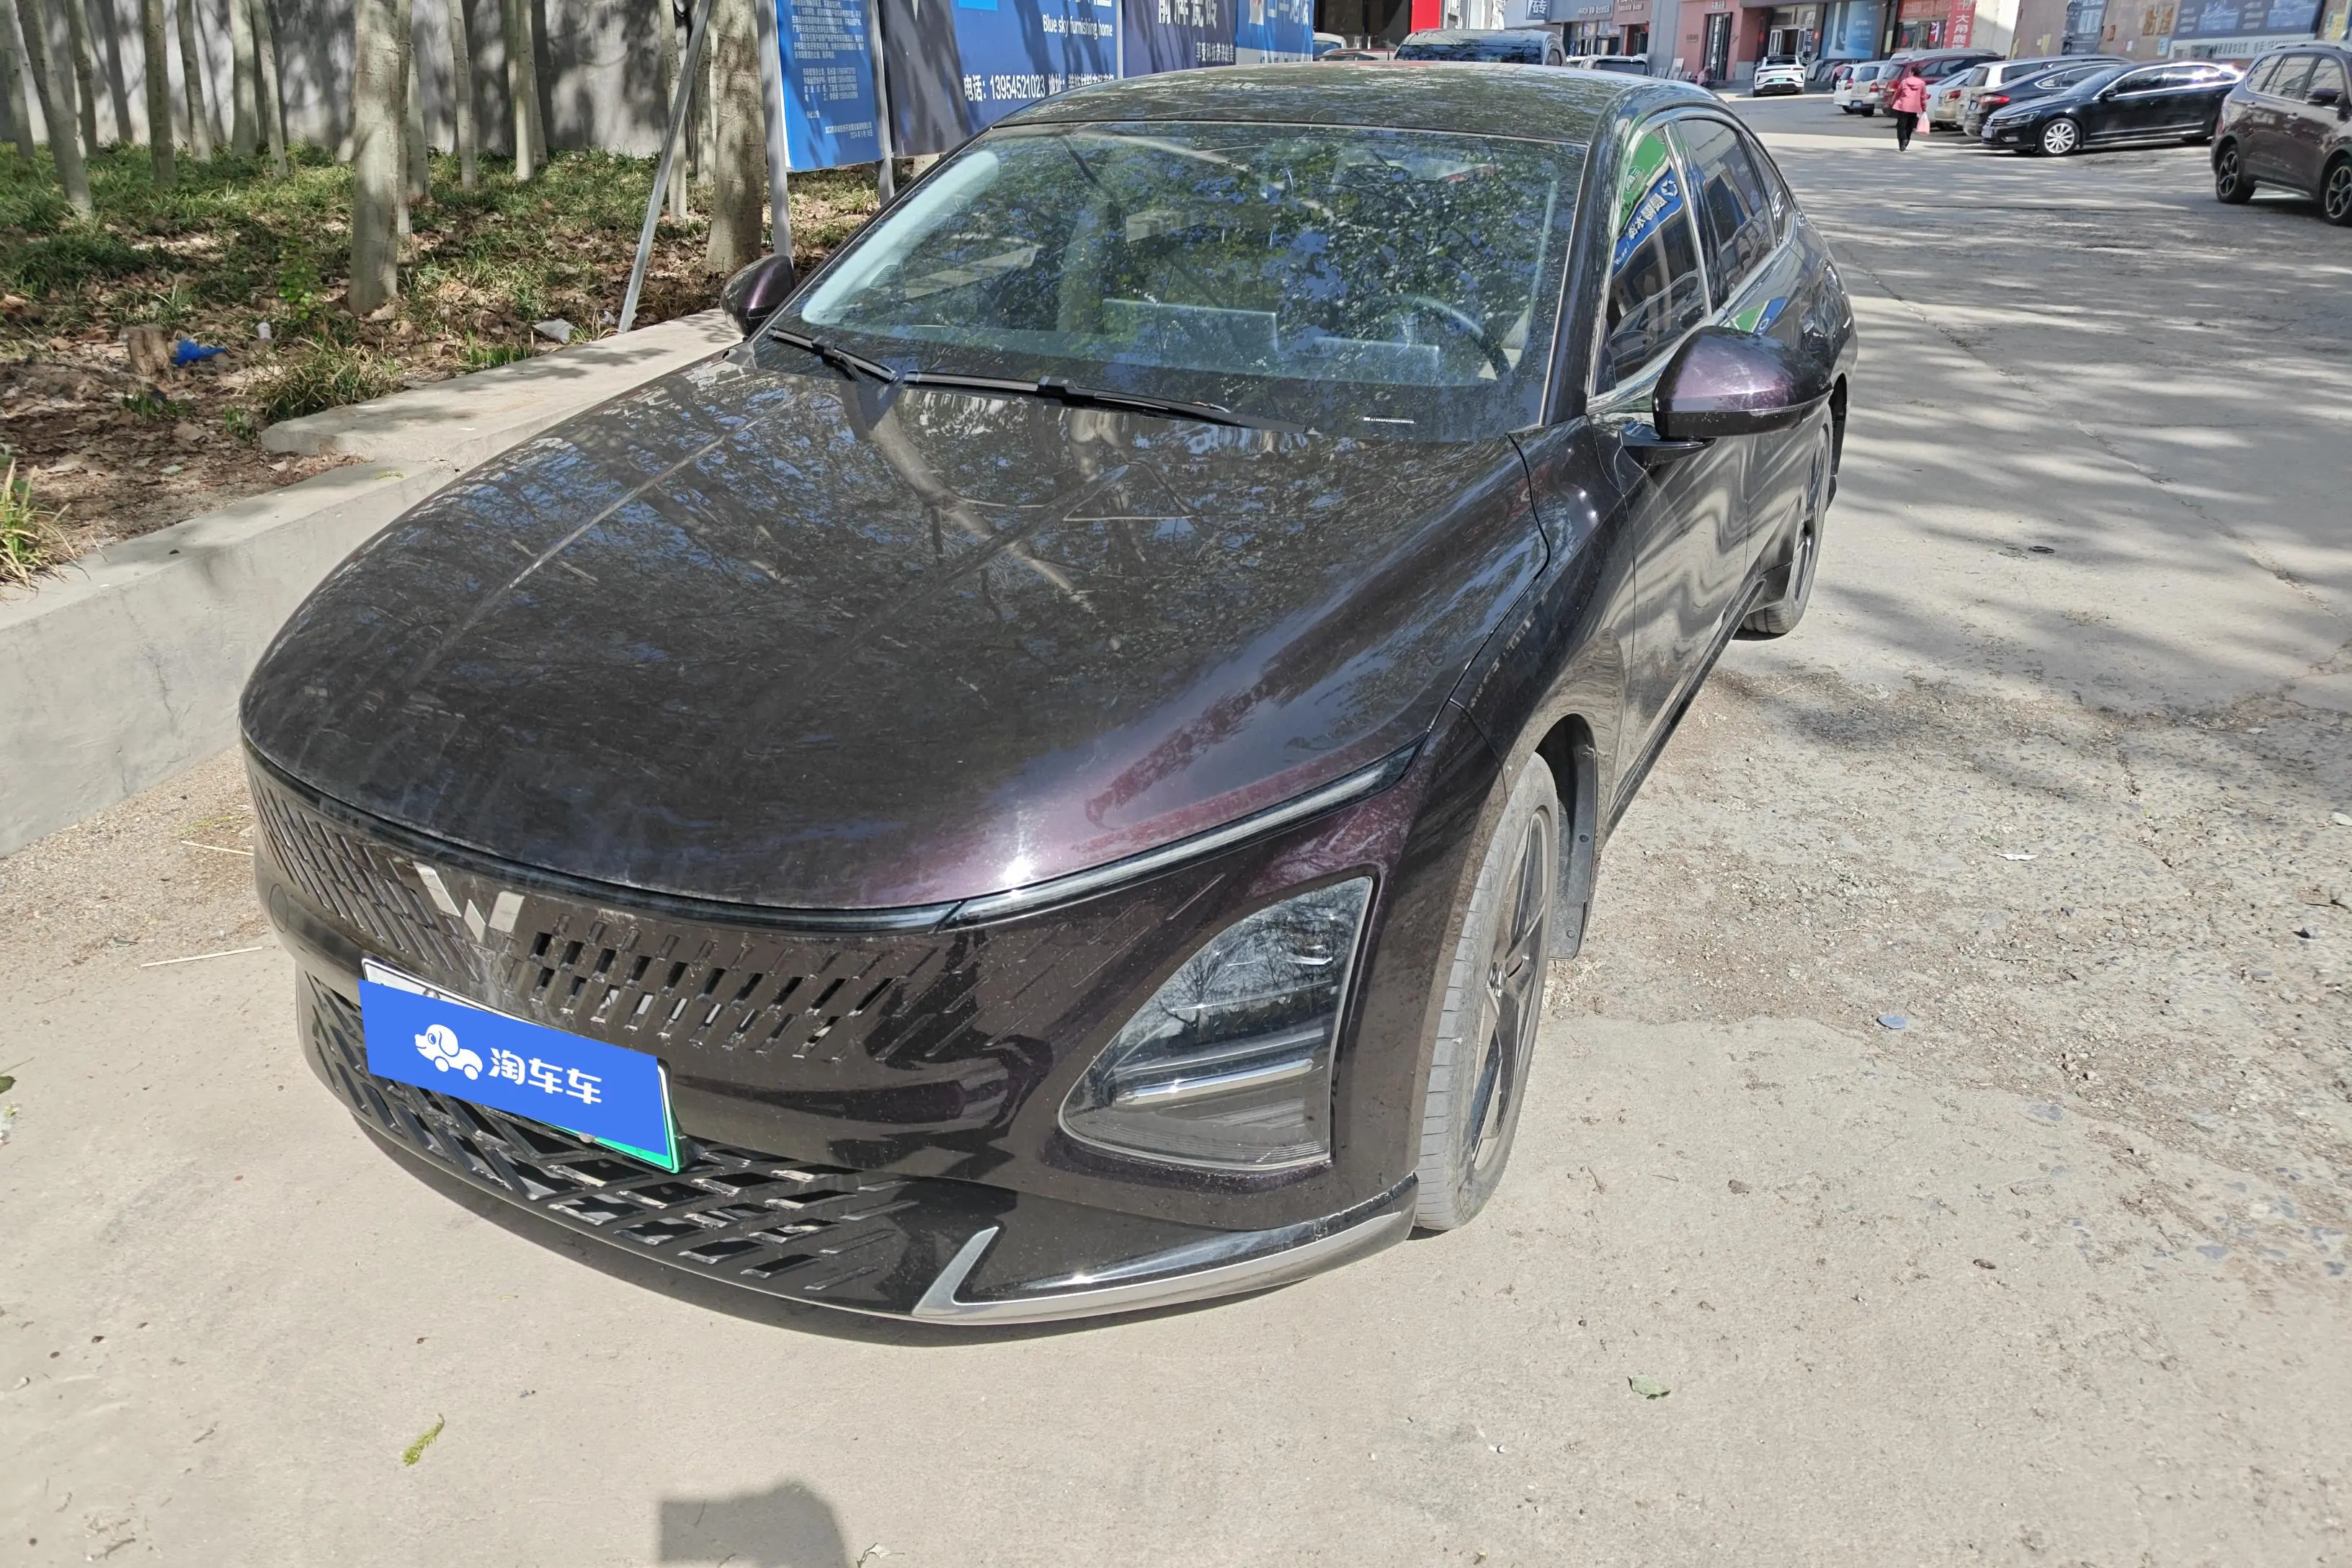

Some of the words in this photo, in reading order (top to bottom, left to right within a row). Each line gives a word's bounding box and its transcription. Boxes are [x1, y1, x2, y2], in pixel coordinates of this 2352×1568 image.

[1042, 13, 1057, 33] Blue
[1058, 14, 1069, 38] sky
[1069, 15, 1098, 40] furnishing
[1098, 19, 1113, 37] home
